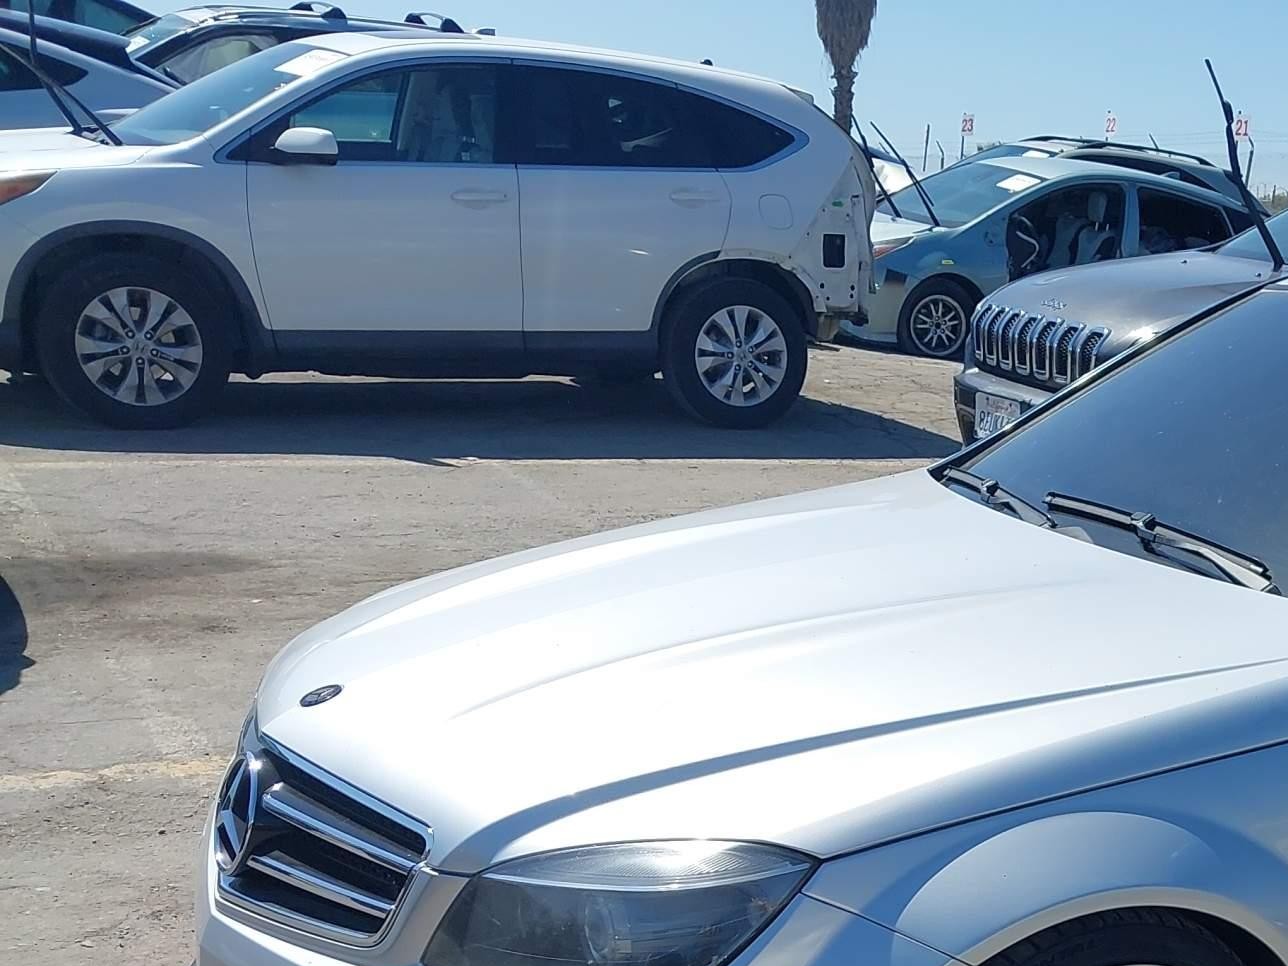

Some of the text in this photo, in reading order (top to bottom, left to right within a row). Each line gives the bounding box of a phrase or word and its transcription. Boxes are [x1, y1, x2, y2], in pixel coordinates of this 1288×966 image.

[961, 118, 974, 132] 23
[1105, 117, 1116, 133] 22
[1235, 119, 1249, 137] 21
